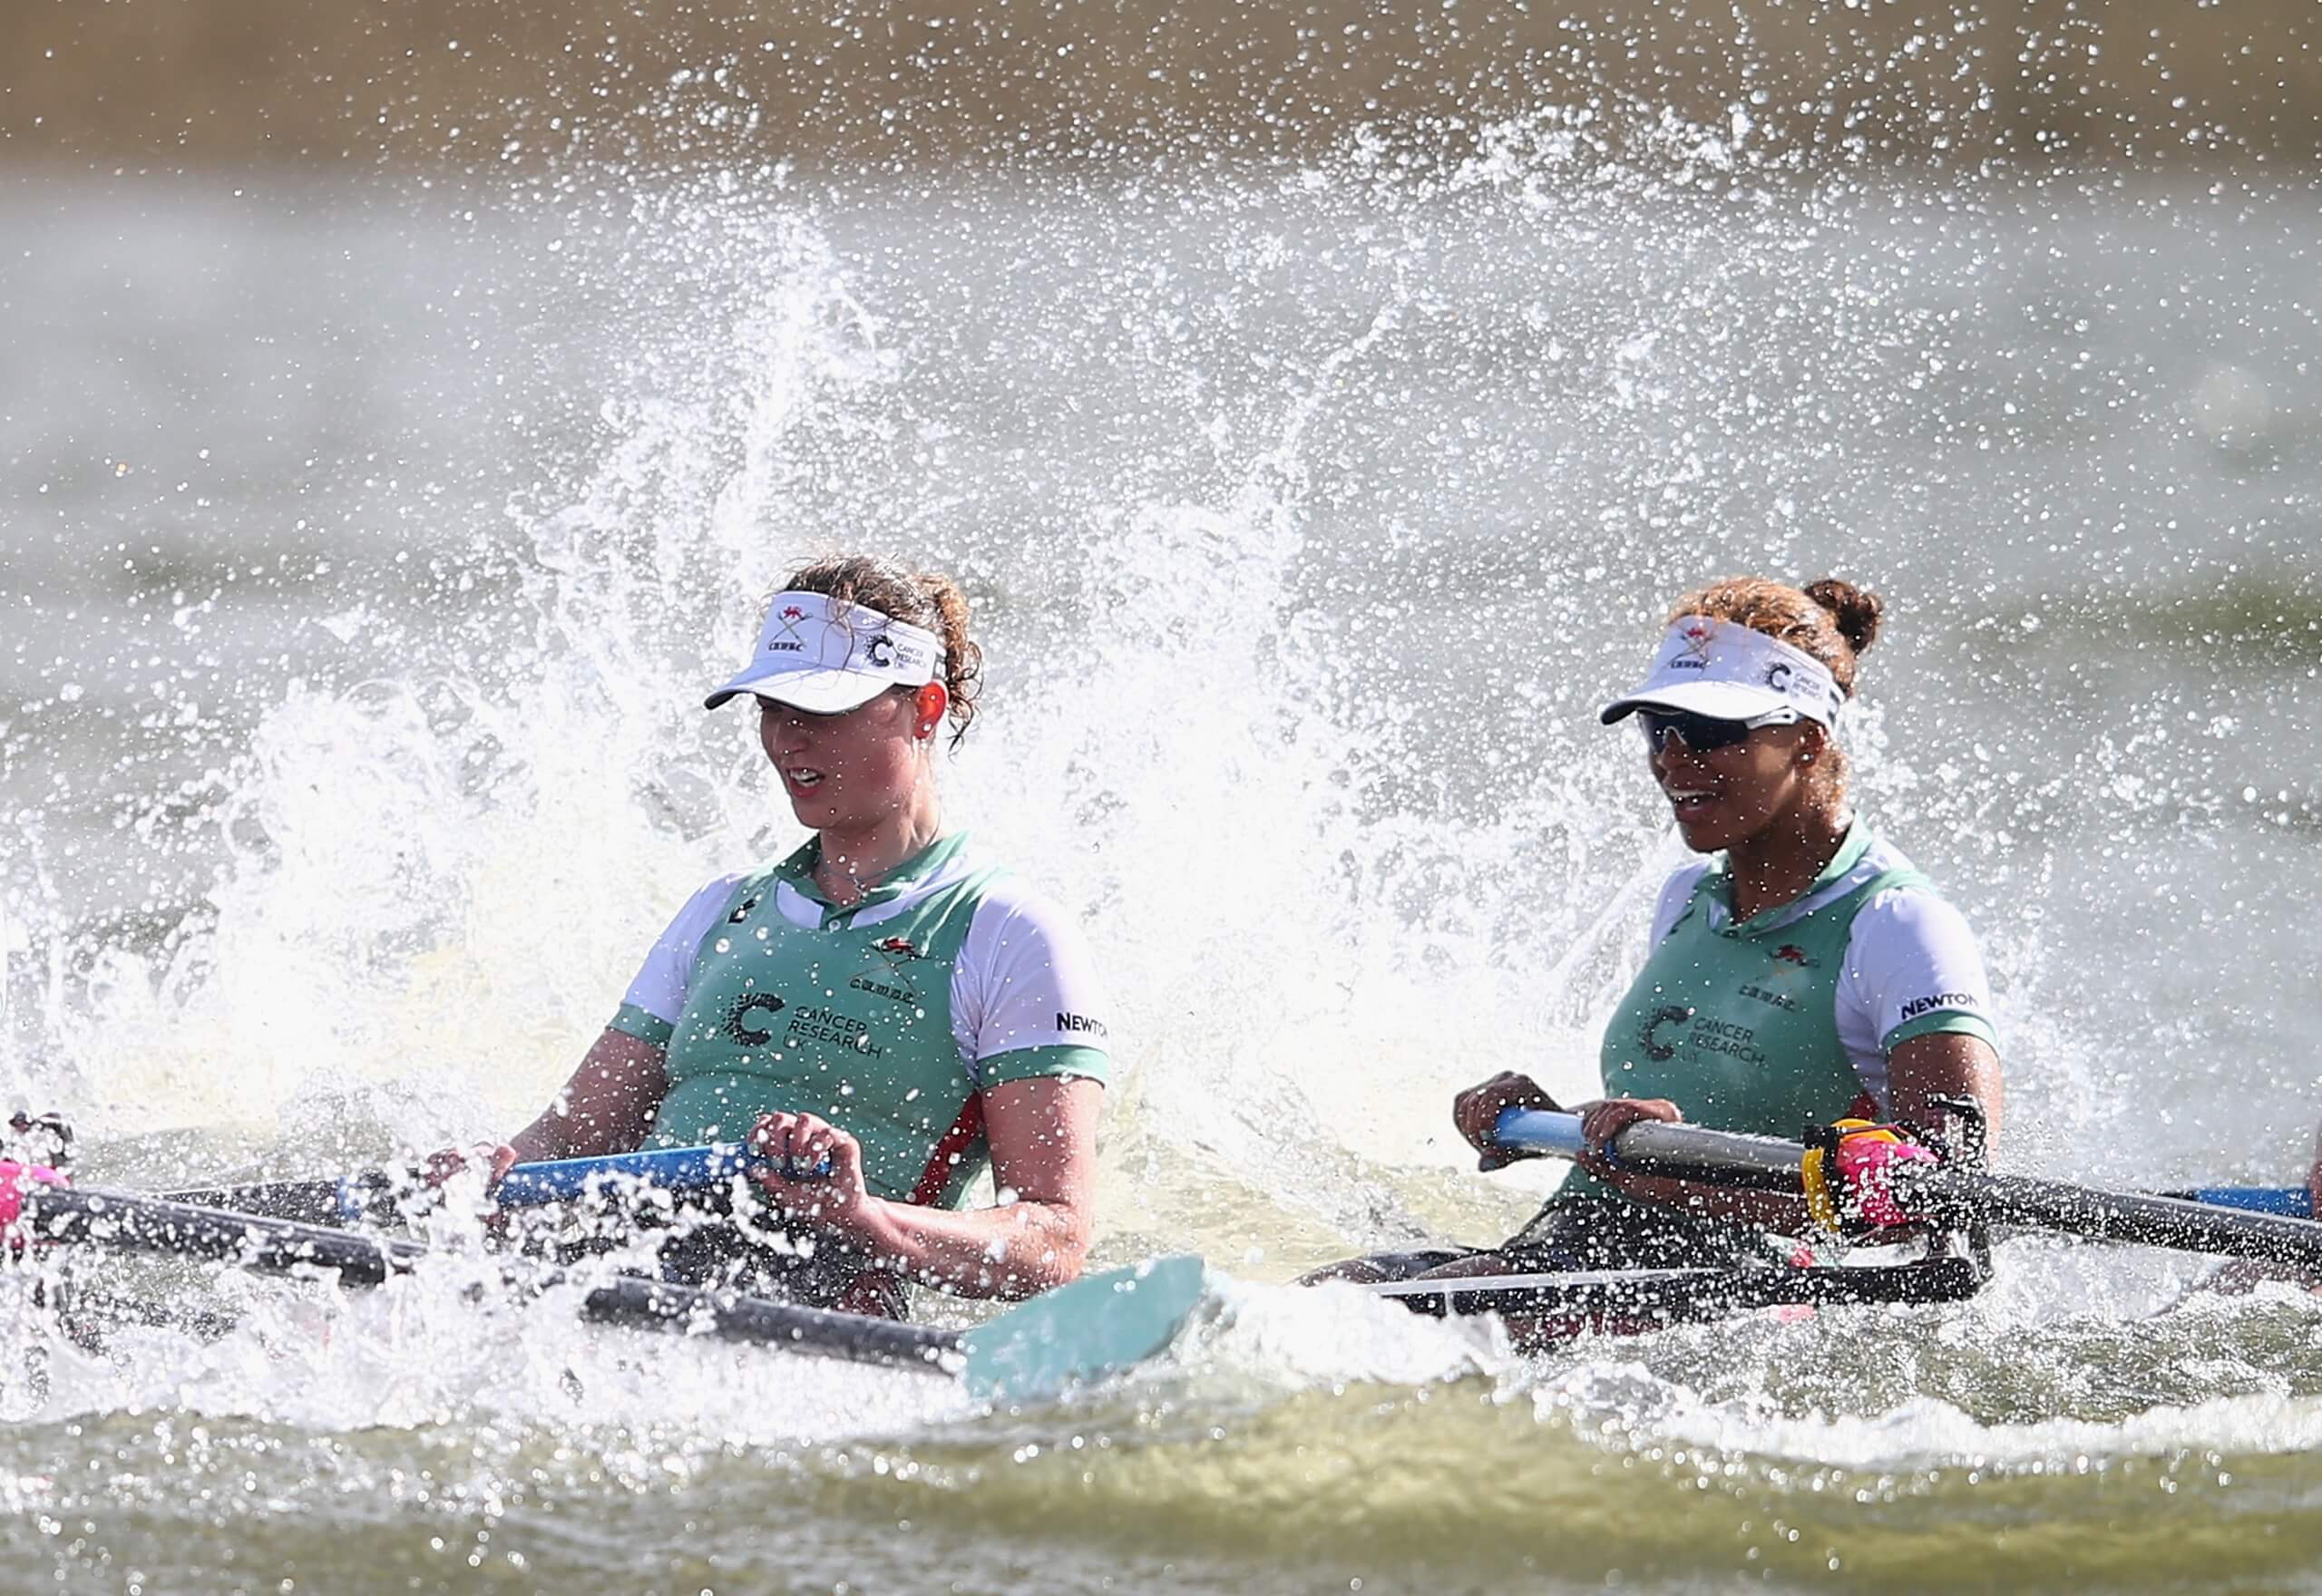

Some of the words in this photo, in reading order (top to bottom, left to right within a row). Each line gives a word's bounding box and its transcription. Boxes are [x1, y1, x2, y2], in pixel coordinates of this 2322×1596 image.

[795, 1006, 867, 1035] CANCER
[1901, 993, 1979, 1020] NEWTON
[787, 1019, 883, 1059] RESEARCH
[1056, 1011, 1108, 1039] NEWTO
[1693, 1017, 1754, 1043] CANCER
[1687, 1031, 1767, 1067] RESEARCH
